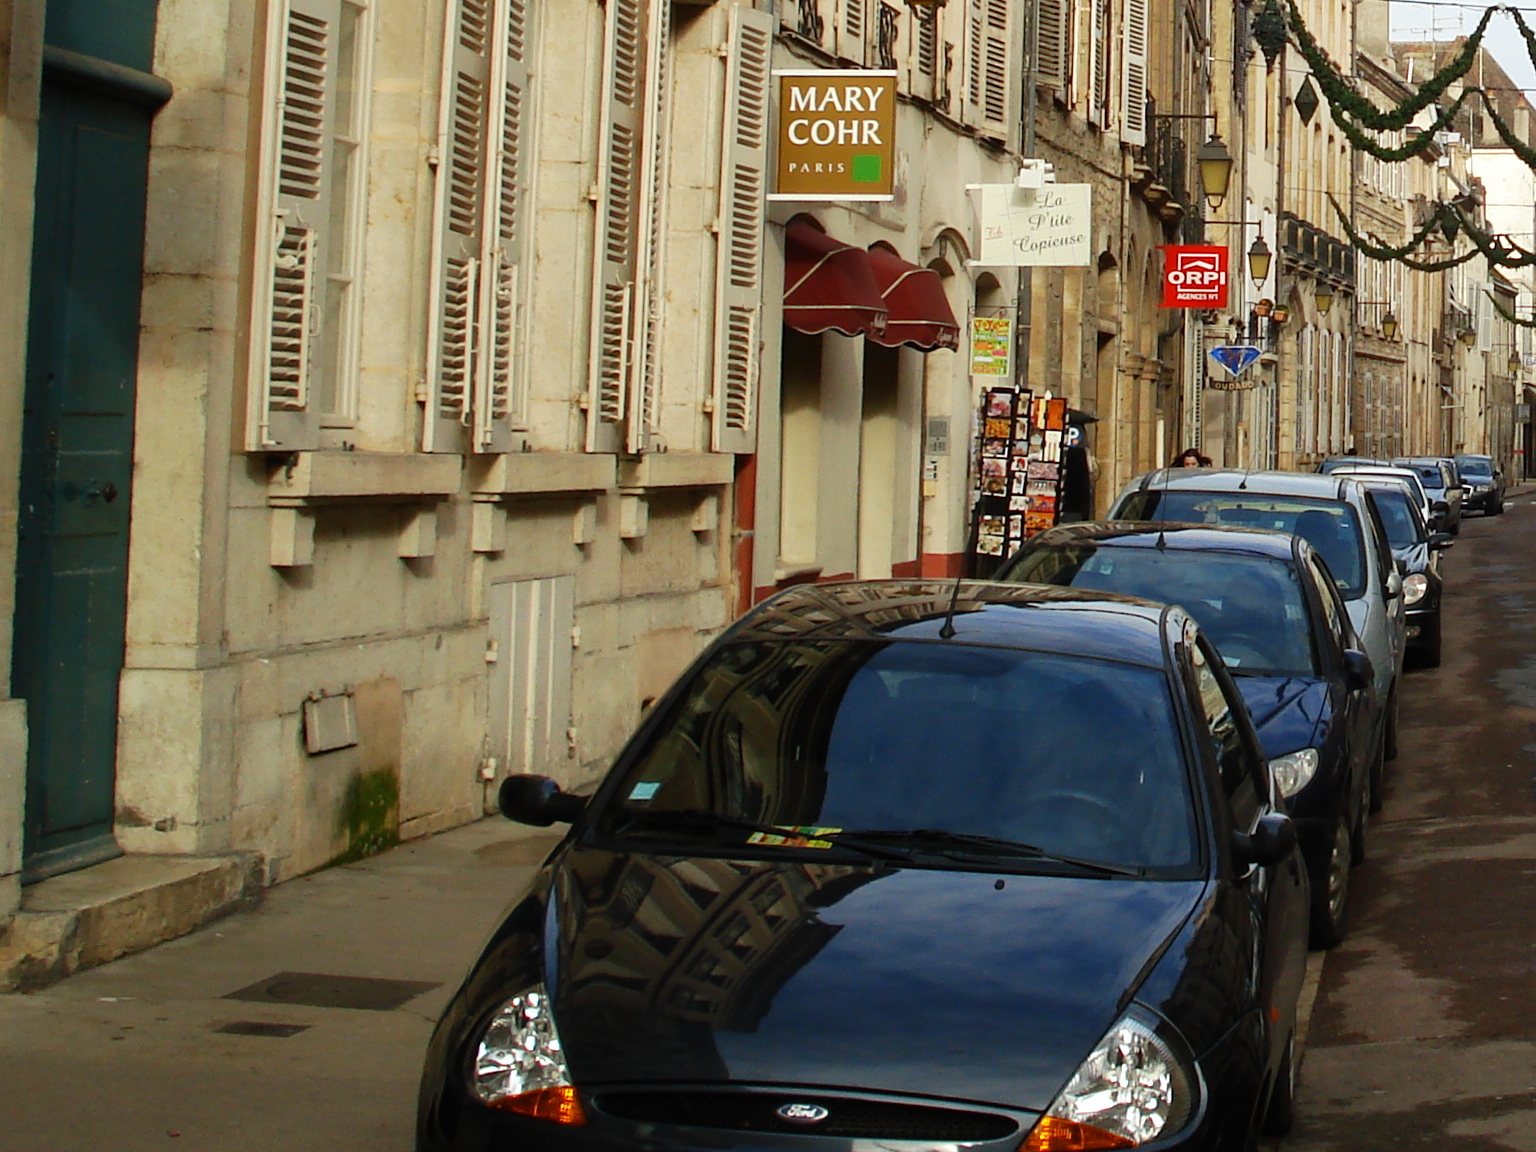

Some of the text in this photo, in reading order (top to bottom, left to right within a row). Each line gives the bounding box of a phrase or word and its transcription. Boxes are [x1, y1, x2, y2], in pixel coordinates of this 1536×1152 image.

[788, 86, 885, 112] MARY
[787, 119, 883, 145] COHR
[788, 162, 845, 173] PARIS
[1034, 191, 1064, 209] La
[1013, 233, 1086, 256] Copieuse
[1167, 271, 1226, 285] ORPI
[787, 1103, 817, 1118] Ford
